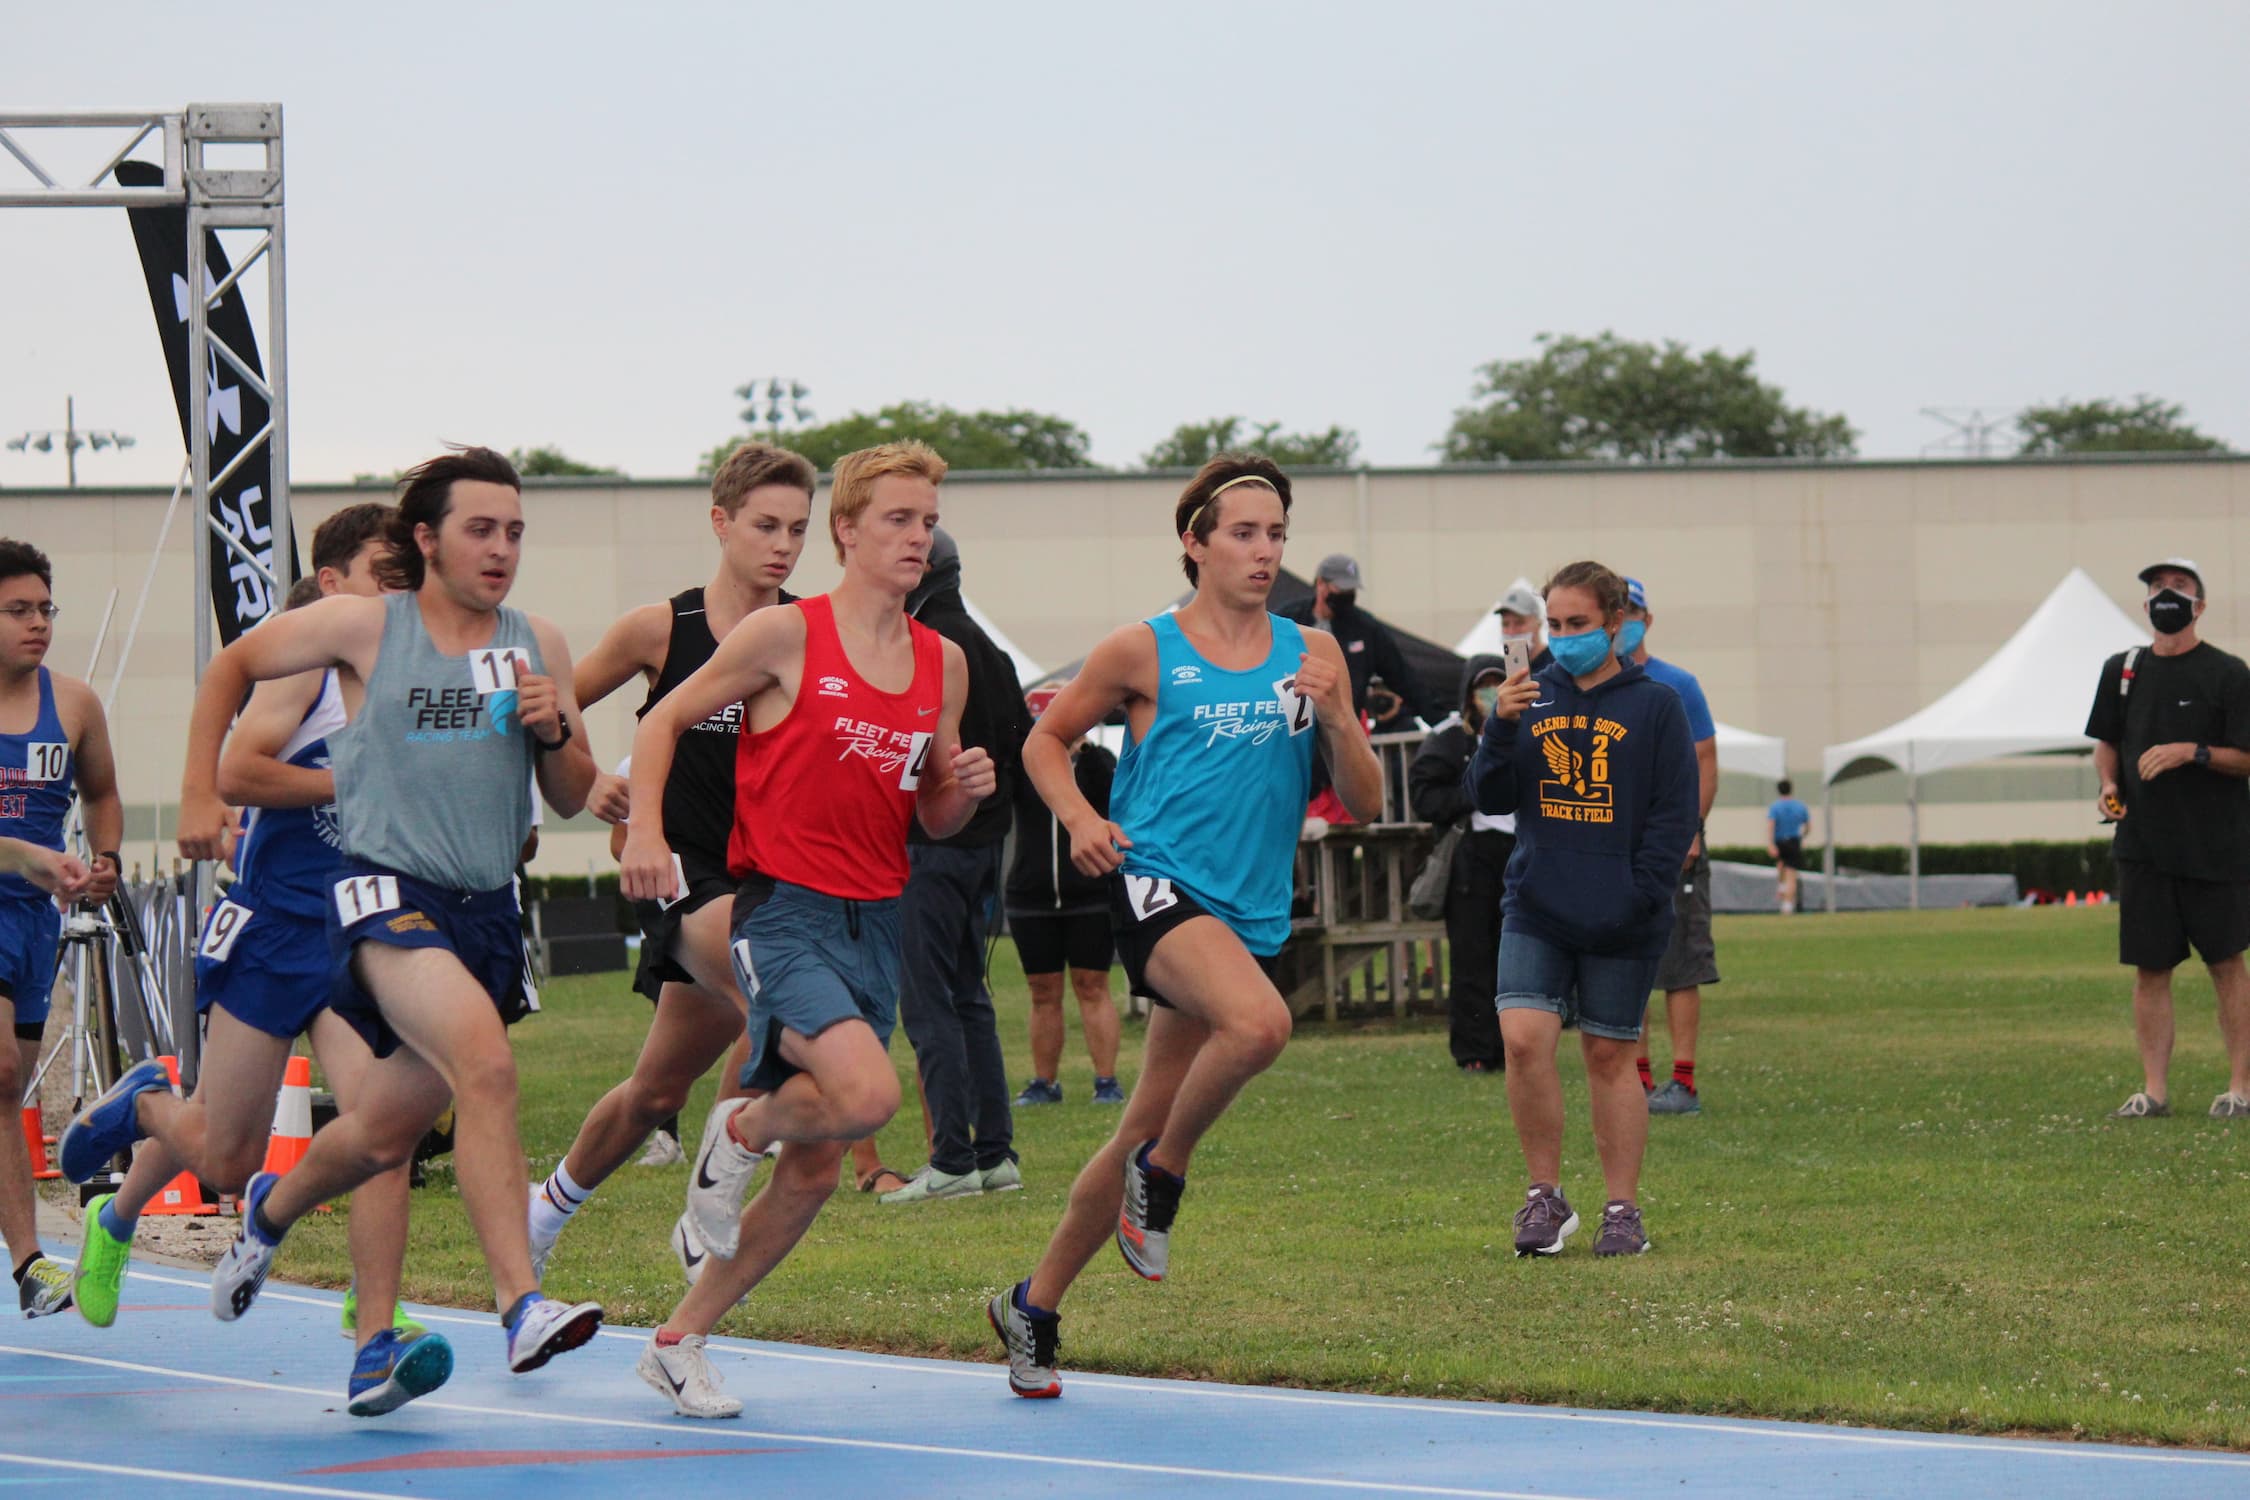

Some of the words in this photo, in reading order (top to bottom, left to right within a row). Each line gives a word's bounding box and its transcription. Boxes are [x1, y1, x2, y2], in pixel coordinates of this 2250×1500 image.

[481, 650, 519, 688] 11
[417, 706, 484, 729] FEET
[1193, 702, 1250, 720] FLEET
[1282, 680, 1310, 732] 2
[405, 731, 454, 744] RACING
[834, 716, 889, 741] FLEET
[1198, 717, 1288, 749] Racing
[1593, 717, 1628, 742] SOUTH
[36, 745, 64, 779] 10
[836, 736, 909, 773] Racing
[1541, 804, 1574, 820] TRACK
[1574, 807, 1583, 821] &
[1584, 807, 1614, 823] FIELD
[344, 876, 384, 917] 11
[1135, 876, 1169, 914] 2
[206, 906, 240, 954] 9
